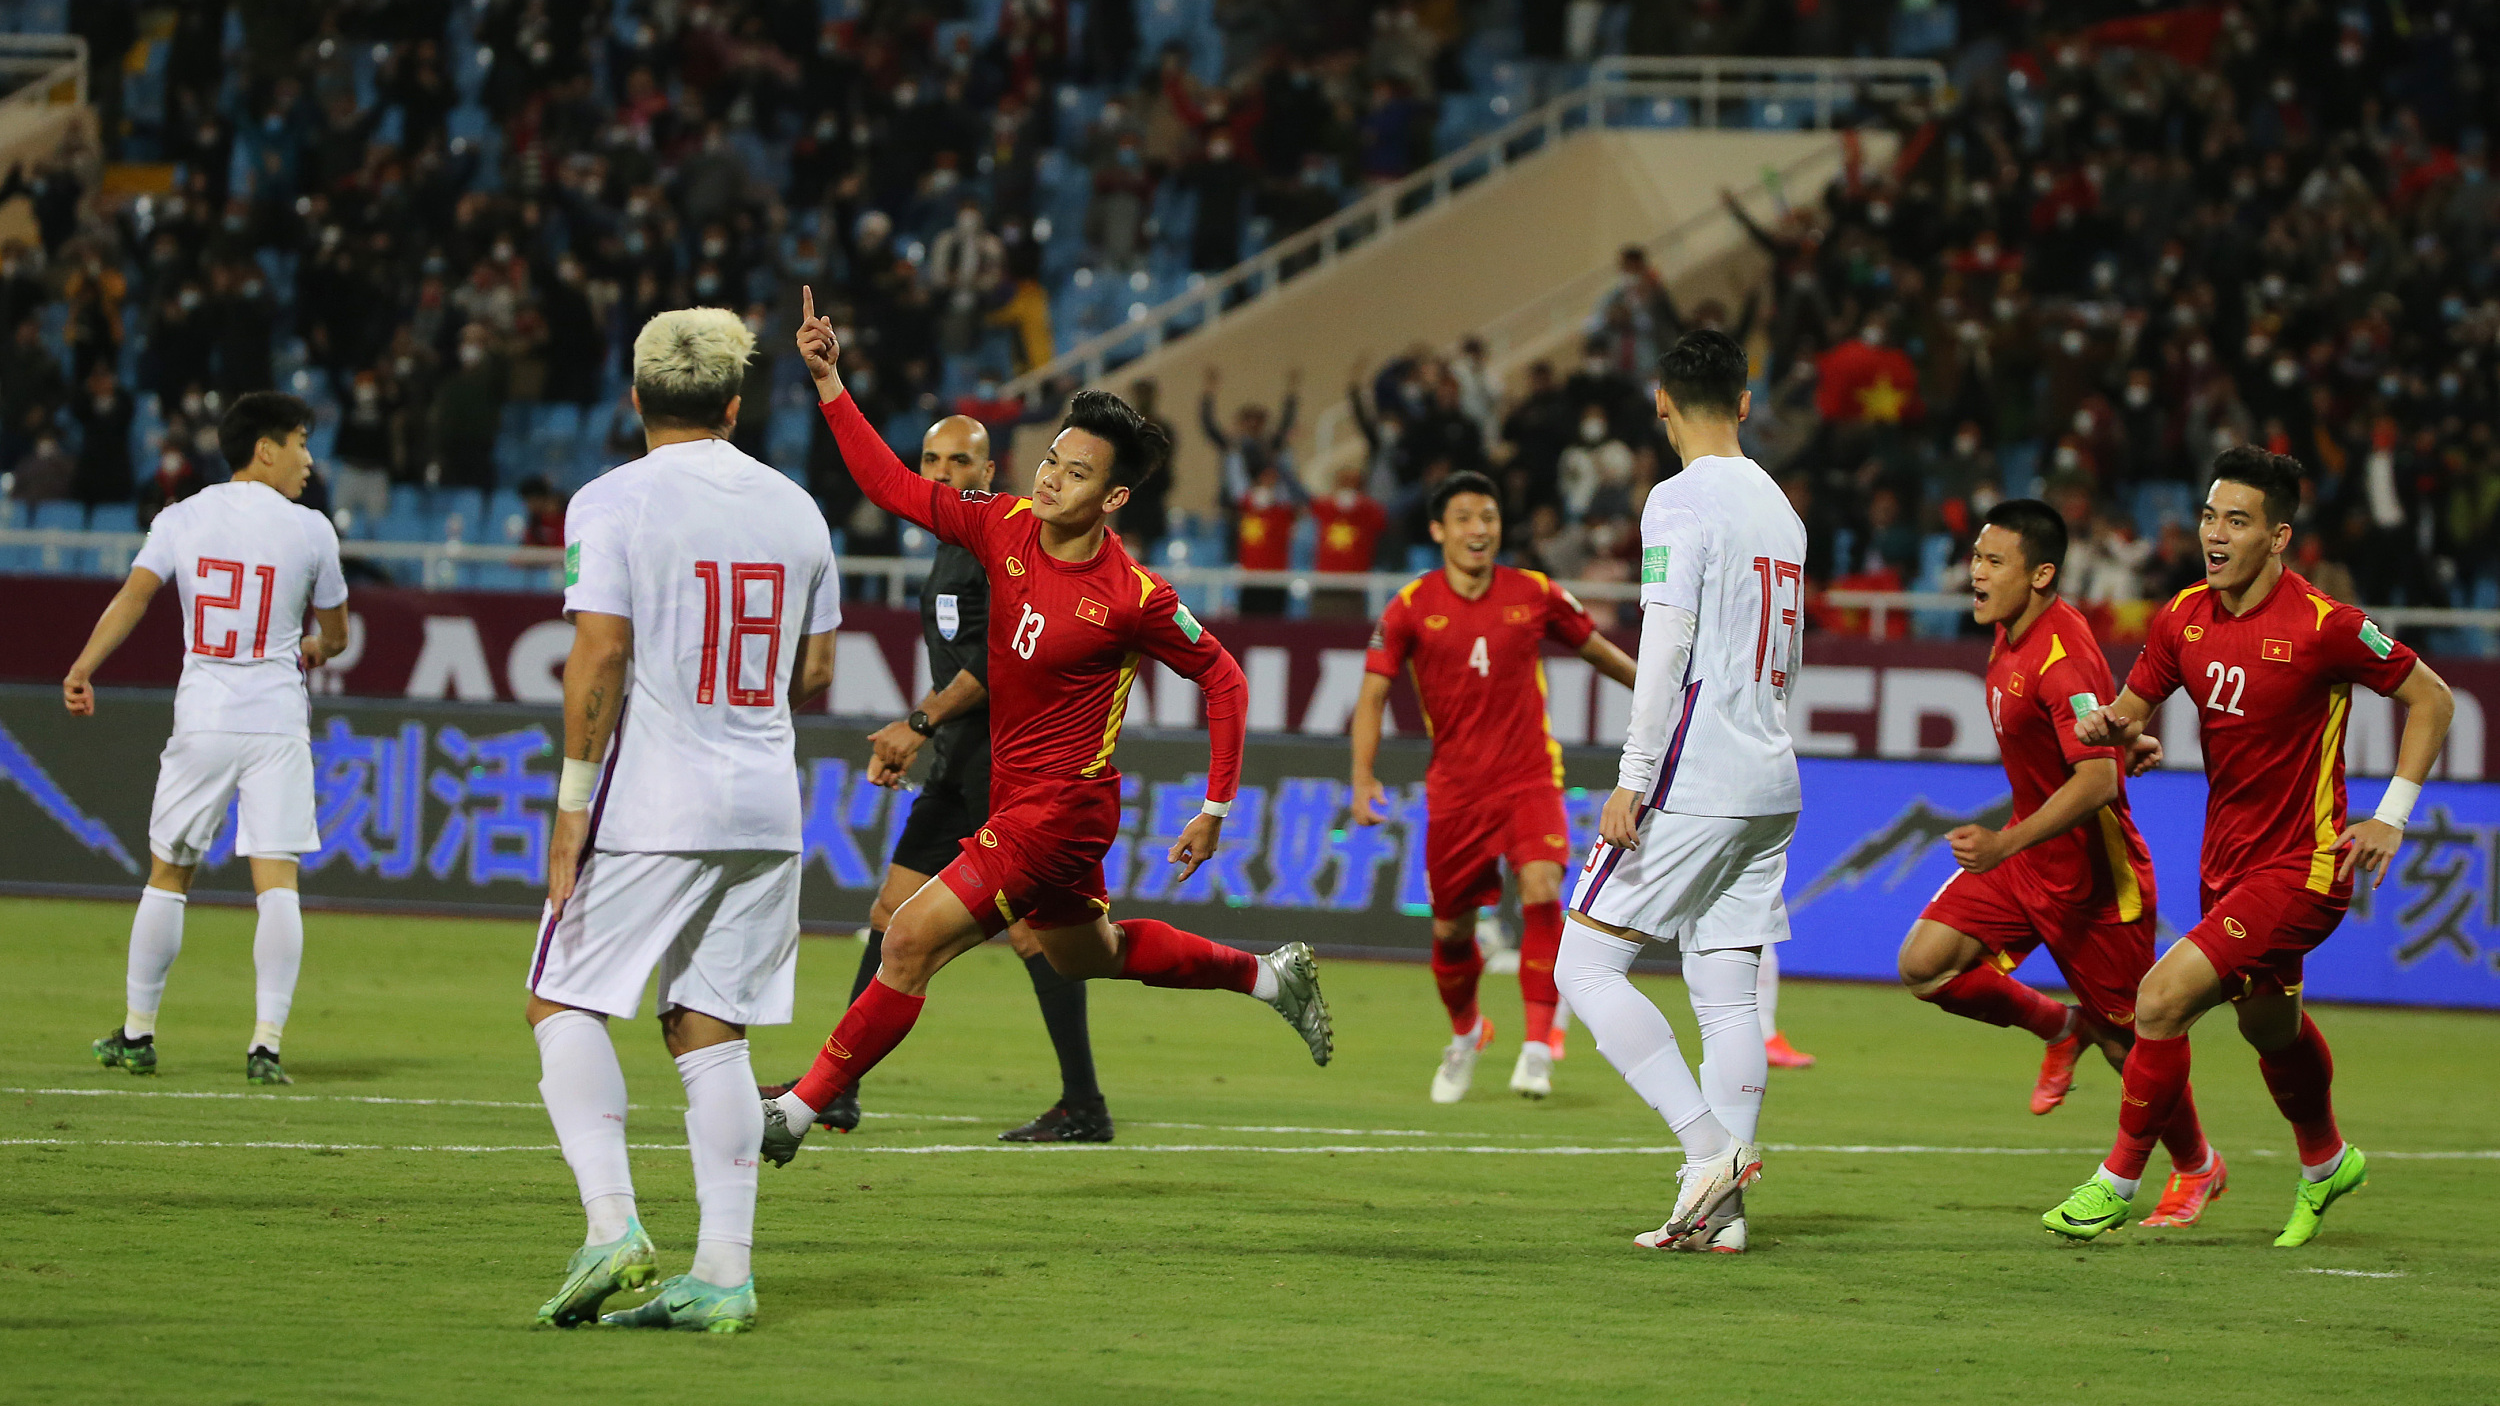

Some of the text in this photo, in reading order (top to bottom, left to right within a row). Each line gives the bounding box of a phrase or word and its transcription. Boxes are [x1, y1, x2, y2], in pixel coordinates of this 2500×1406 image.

[192, 556, 275, 658] 21
[695, 560, 785, 707] 18
[1011, 602, 1045, 660] 13
[1753, 556, 1801, 688] 13
[1468, 635, 1491, 677] 4
[2206, 661, 2246, 717] 22
